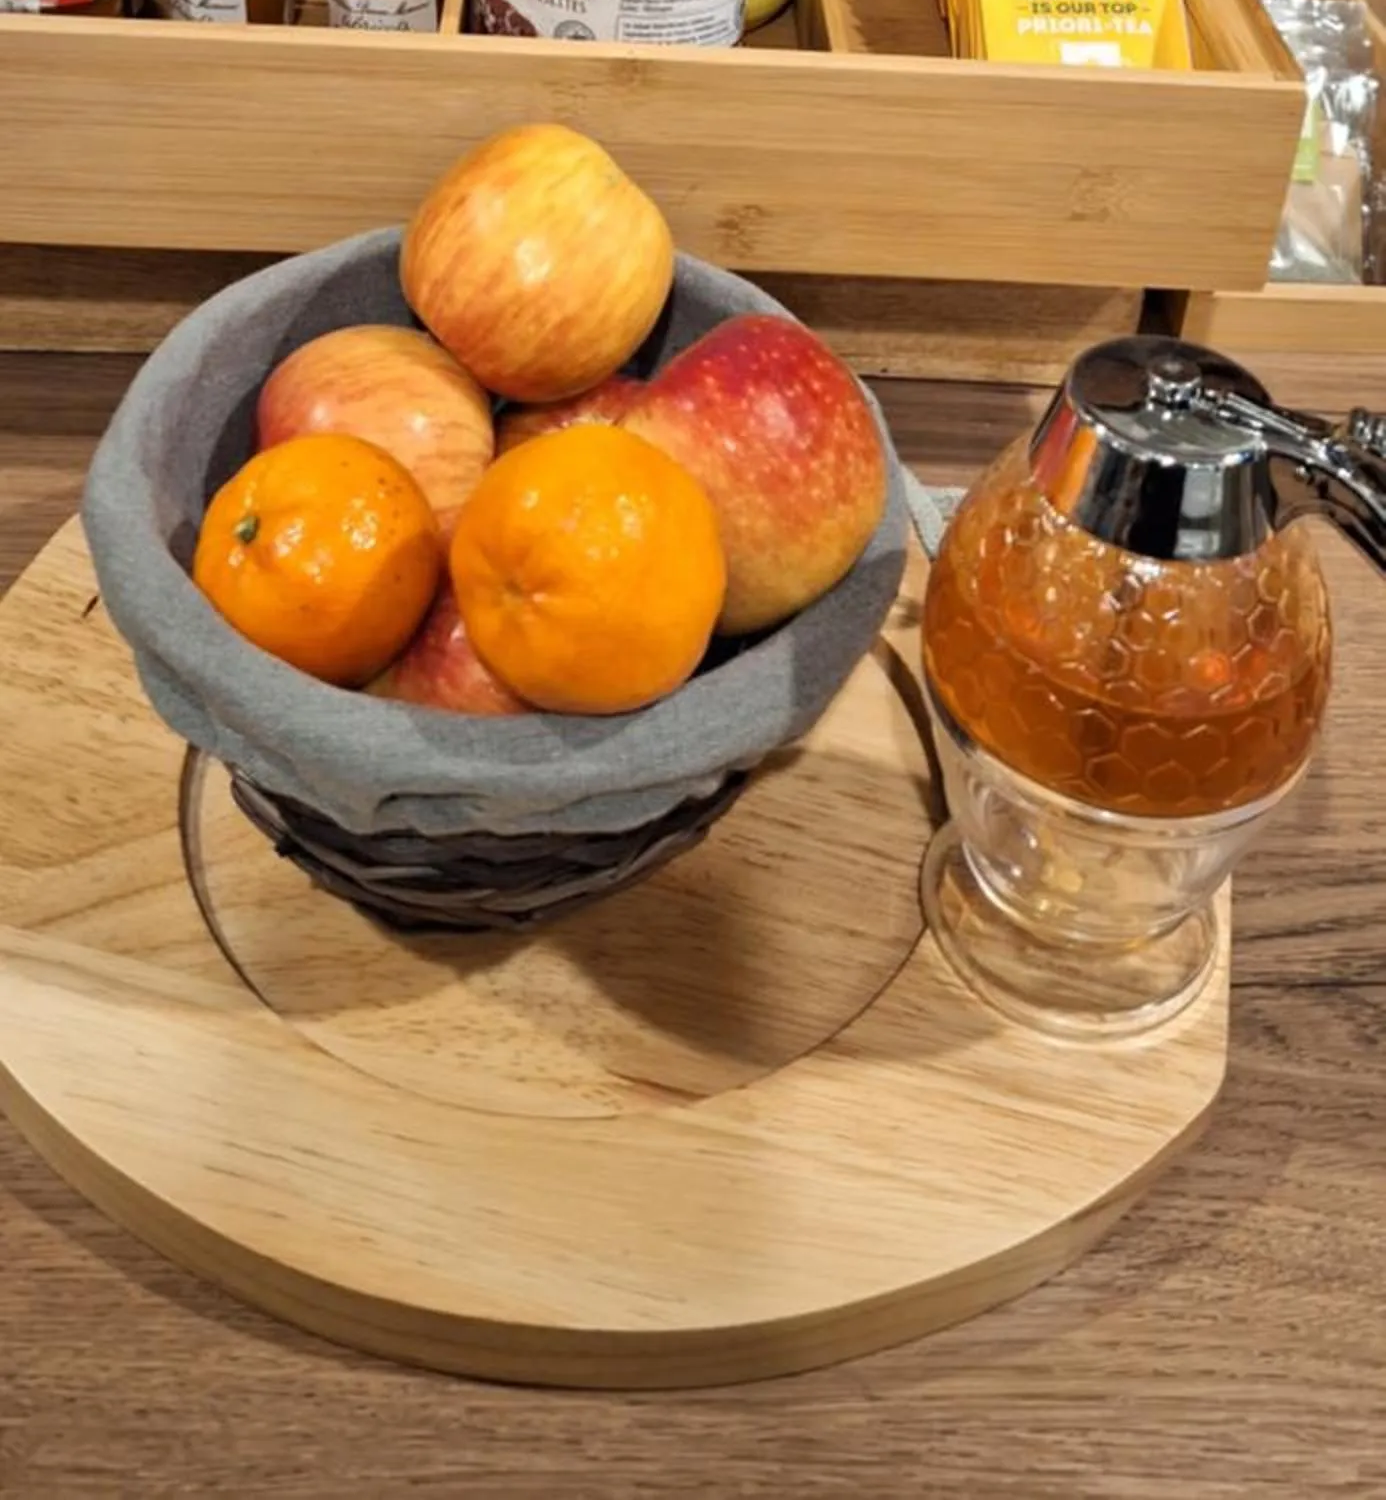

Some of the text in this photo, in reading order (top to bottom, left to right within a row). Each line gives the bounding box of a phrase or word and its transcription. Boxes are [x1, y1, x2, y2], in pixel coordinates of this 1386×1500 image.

[1032, 2, 1138, 14] IS OUR TOP
